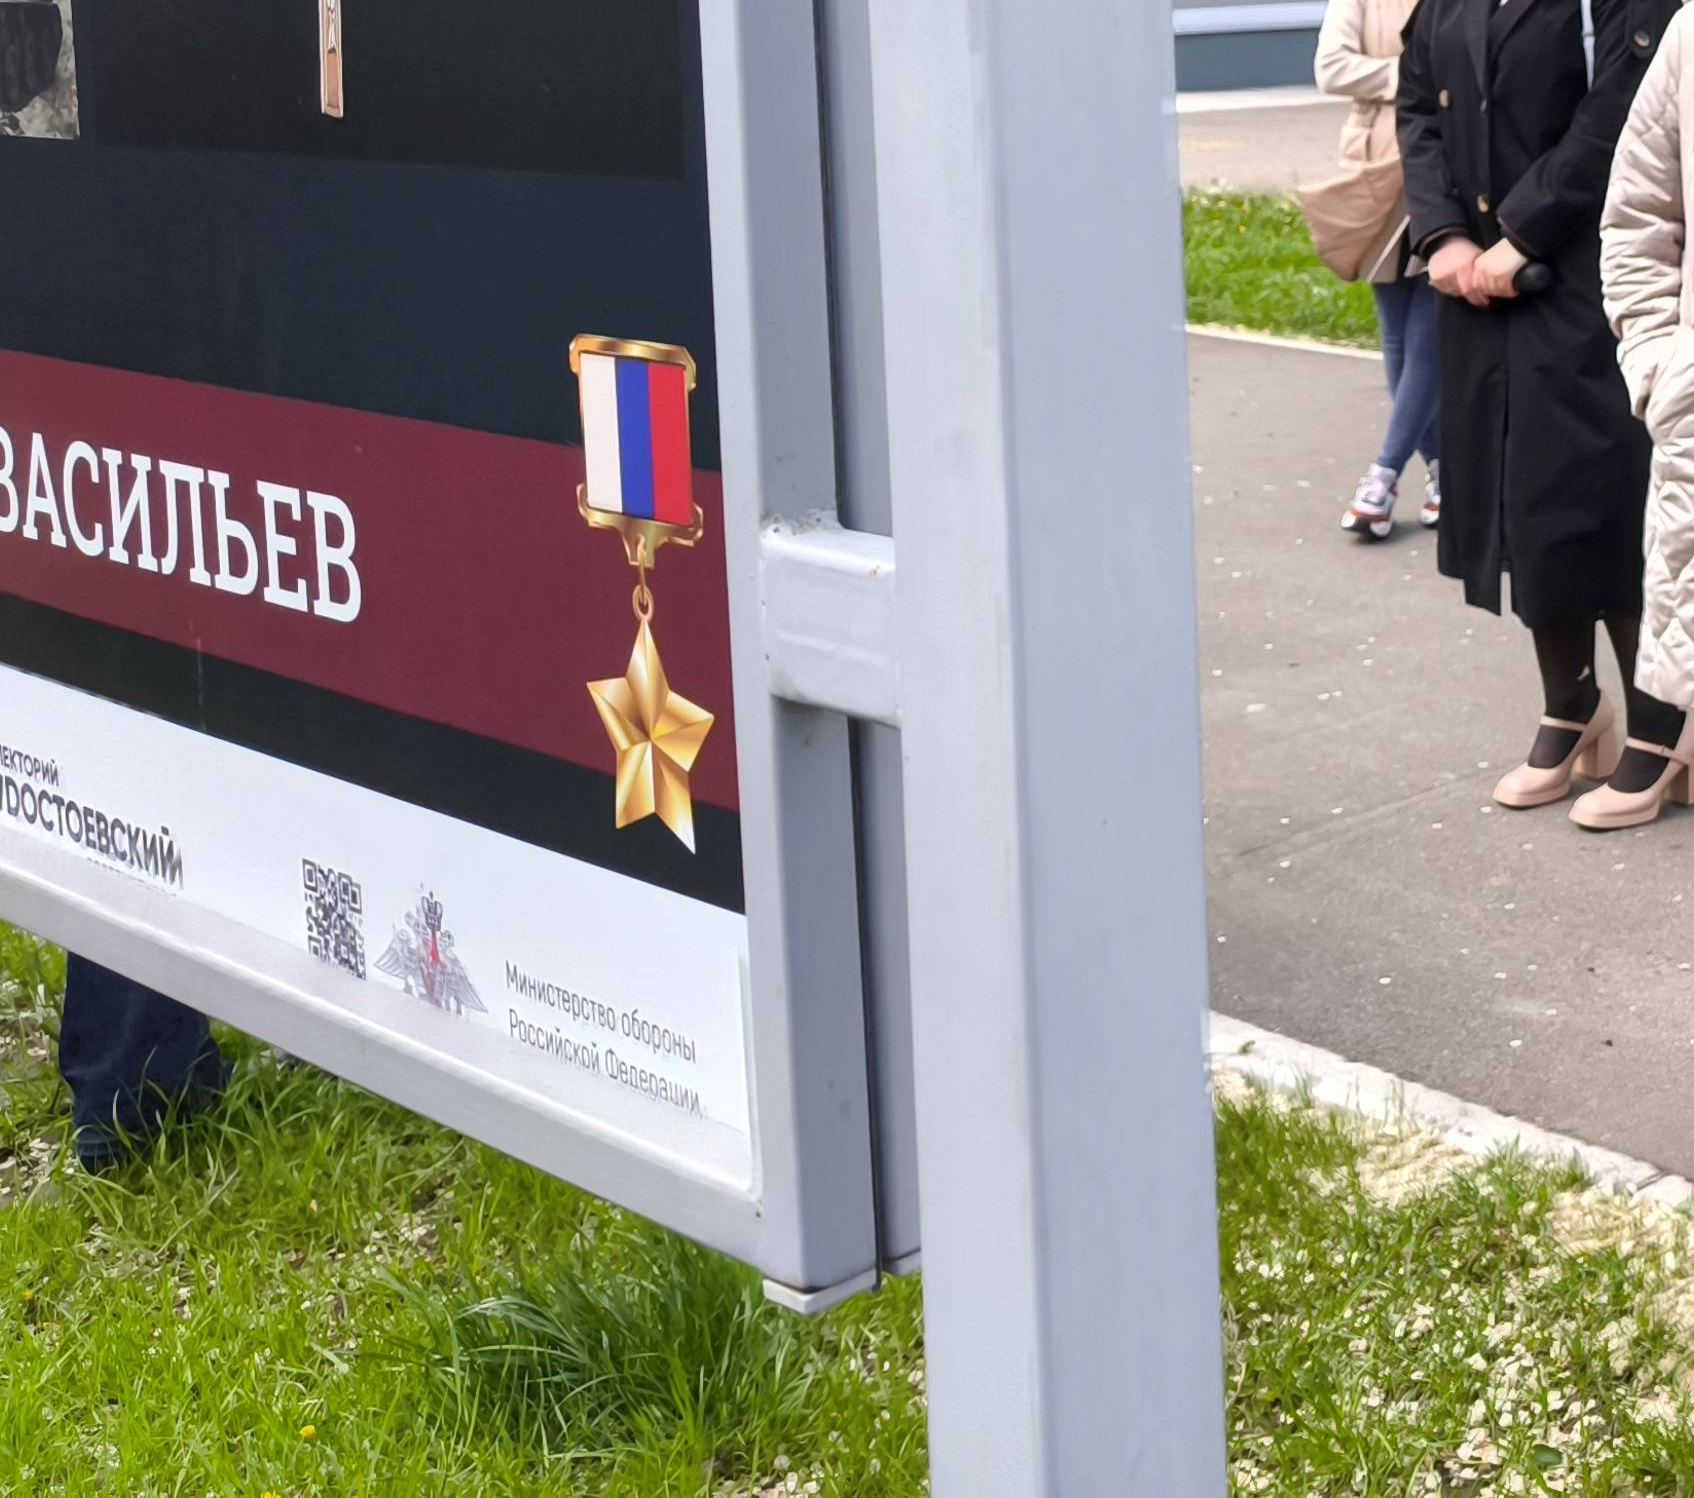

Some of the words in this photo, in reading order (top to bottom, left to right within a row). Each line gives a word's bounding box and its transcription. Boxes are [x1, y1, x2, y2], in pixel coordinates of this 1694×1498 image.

[505, 959, 616, 1032] Министерство
[621, 1008, 697, 1063] обороны
[509, 1008, 601, 1074] Российской
